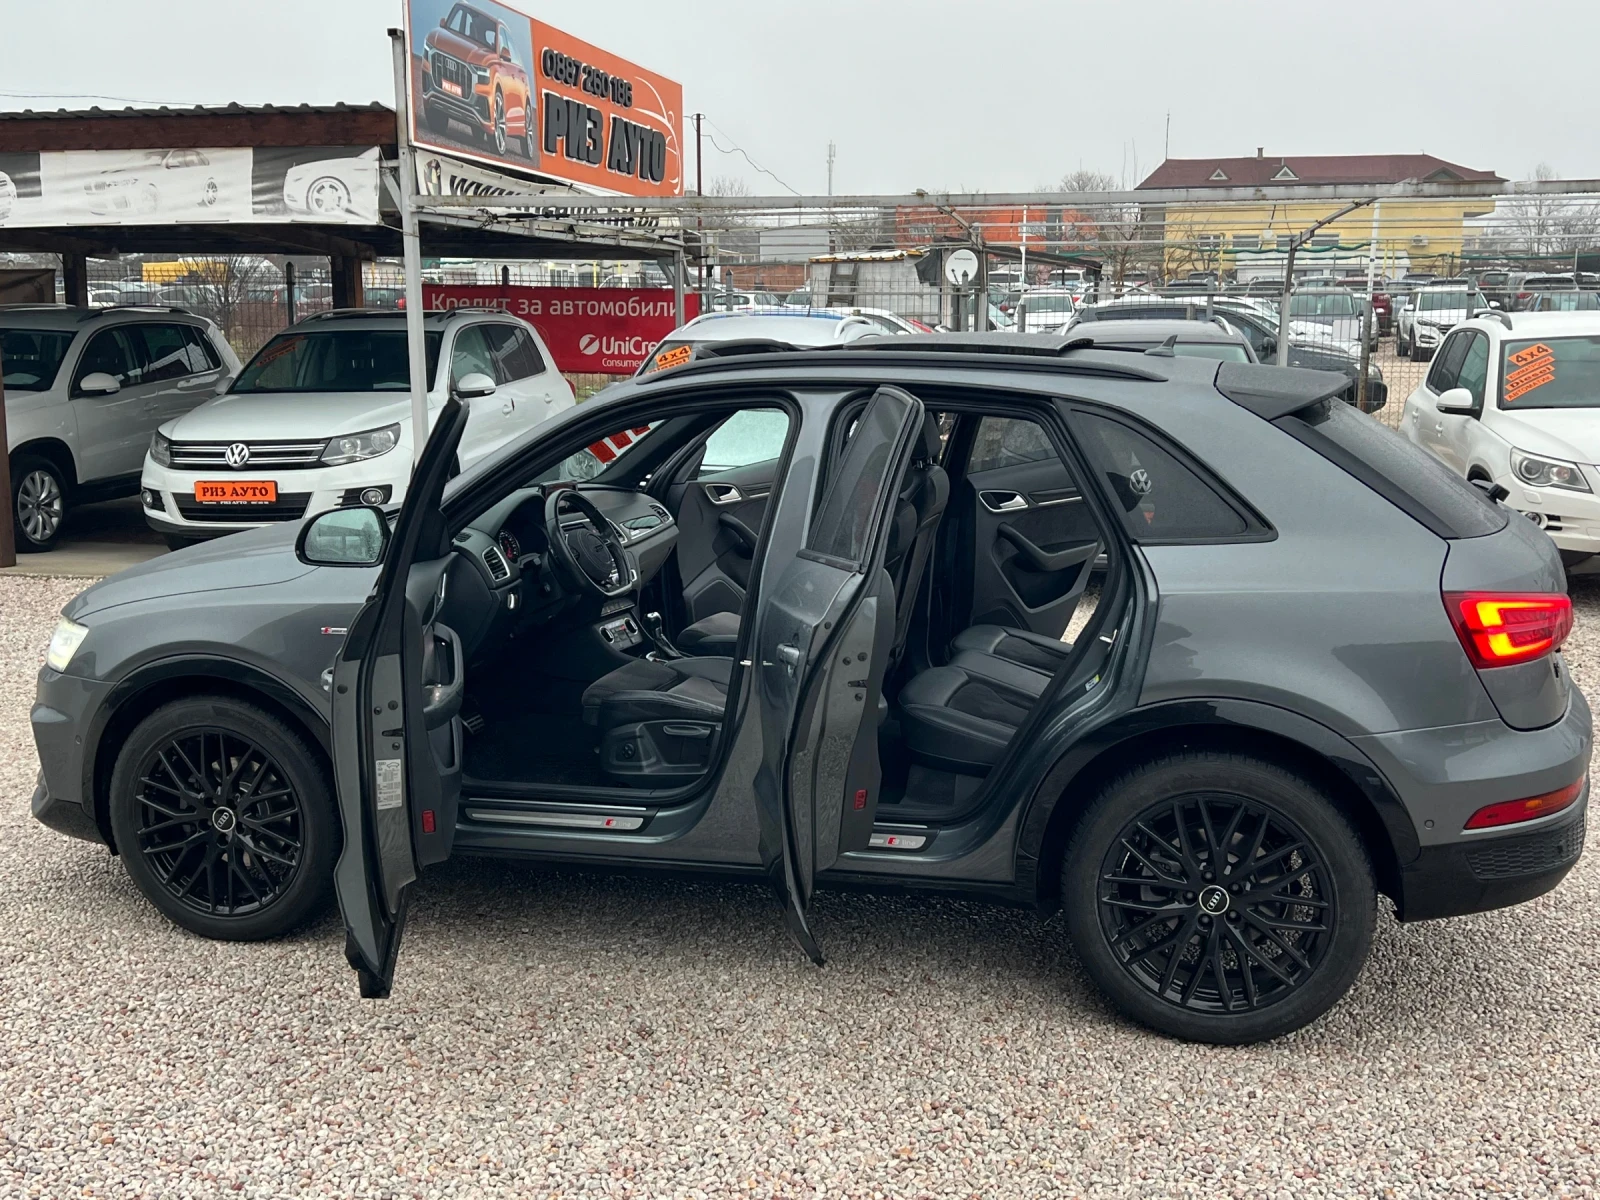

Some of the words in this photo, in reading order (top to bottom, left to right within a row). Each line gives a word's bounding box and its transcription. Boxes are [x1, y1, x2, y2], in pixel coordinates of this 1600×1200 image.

[542, 47, 582, 87] 0887
[582, 63, 609, 99] 260
[609, 74, 632, 108] 186
[542, 88, 603, 167] РИЗ
[606, 113, 666, 185] АУТО
[431, 293, 510, 311] Кредит
[518, 299, 542, 316] за
[1510, 366, 1551, 388] Diesel
[202, 487, 226, 497] РИЗ
[230, 487, 269, 497] АУТО
